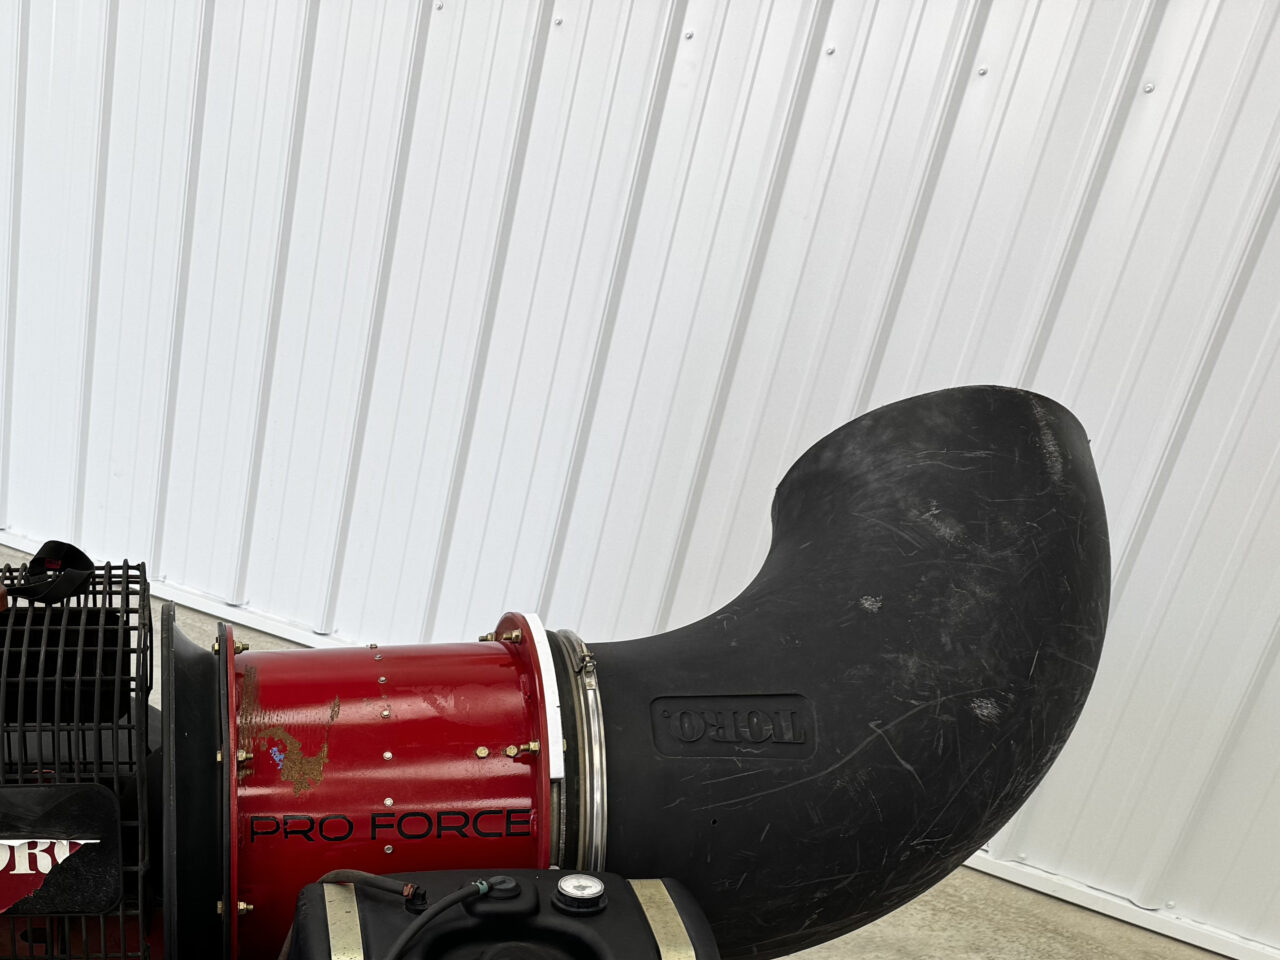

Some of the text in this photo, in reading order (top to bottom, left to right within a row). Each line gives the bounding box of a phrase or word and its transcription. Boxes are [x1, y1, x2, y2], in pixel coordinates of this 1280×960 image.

[671, 710, 806, 745] TORO
[250, 808, 532, 843] PRO FORCE
